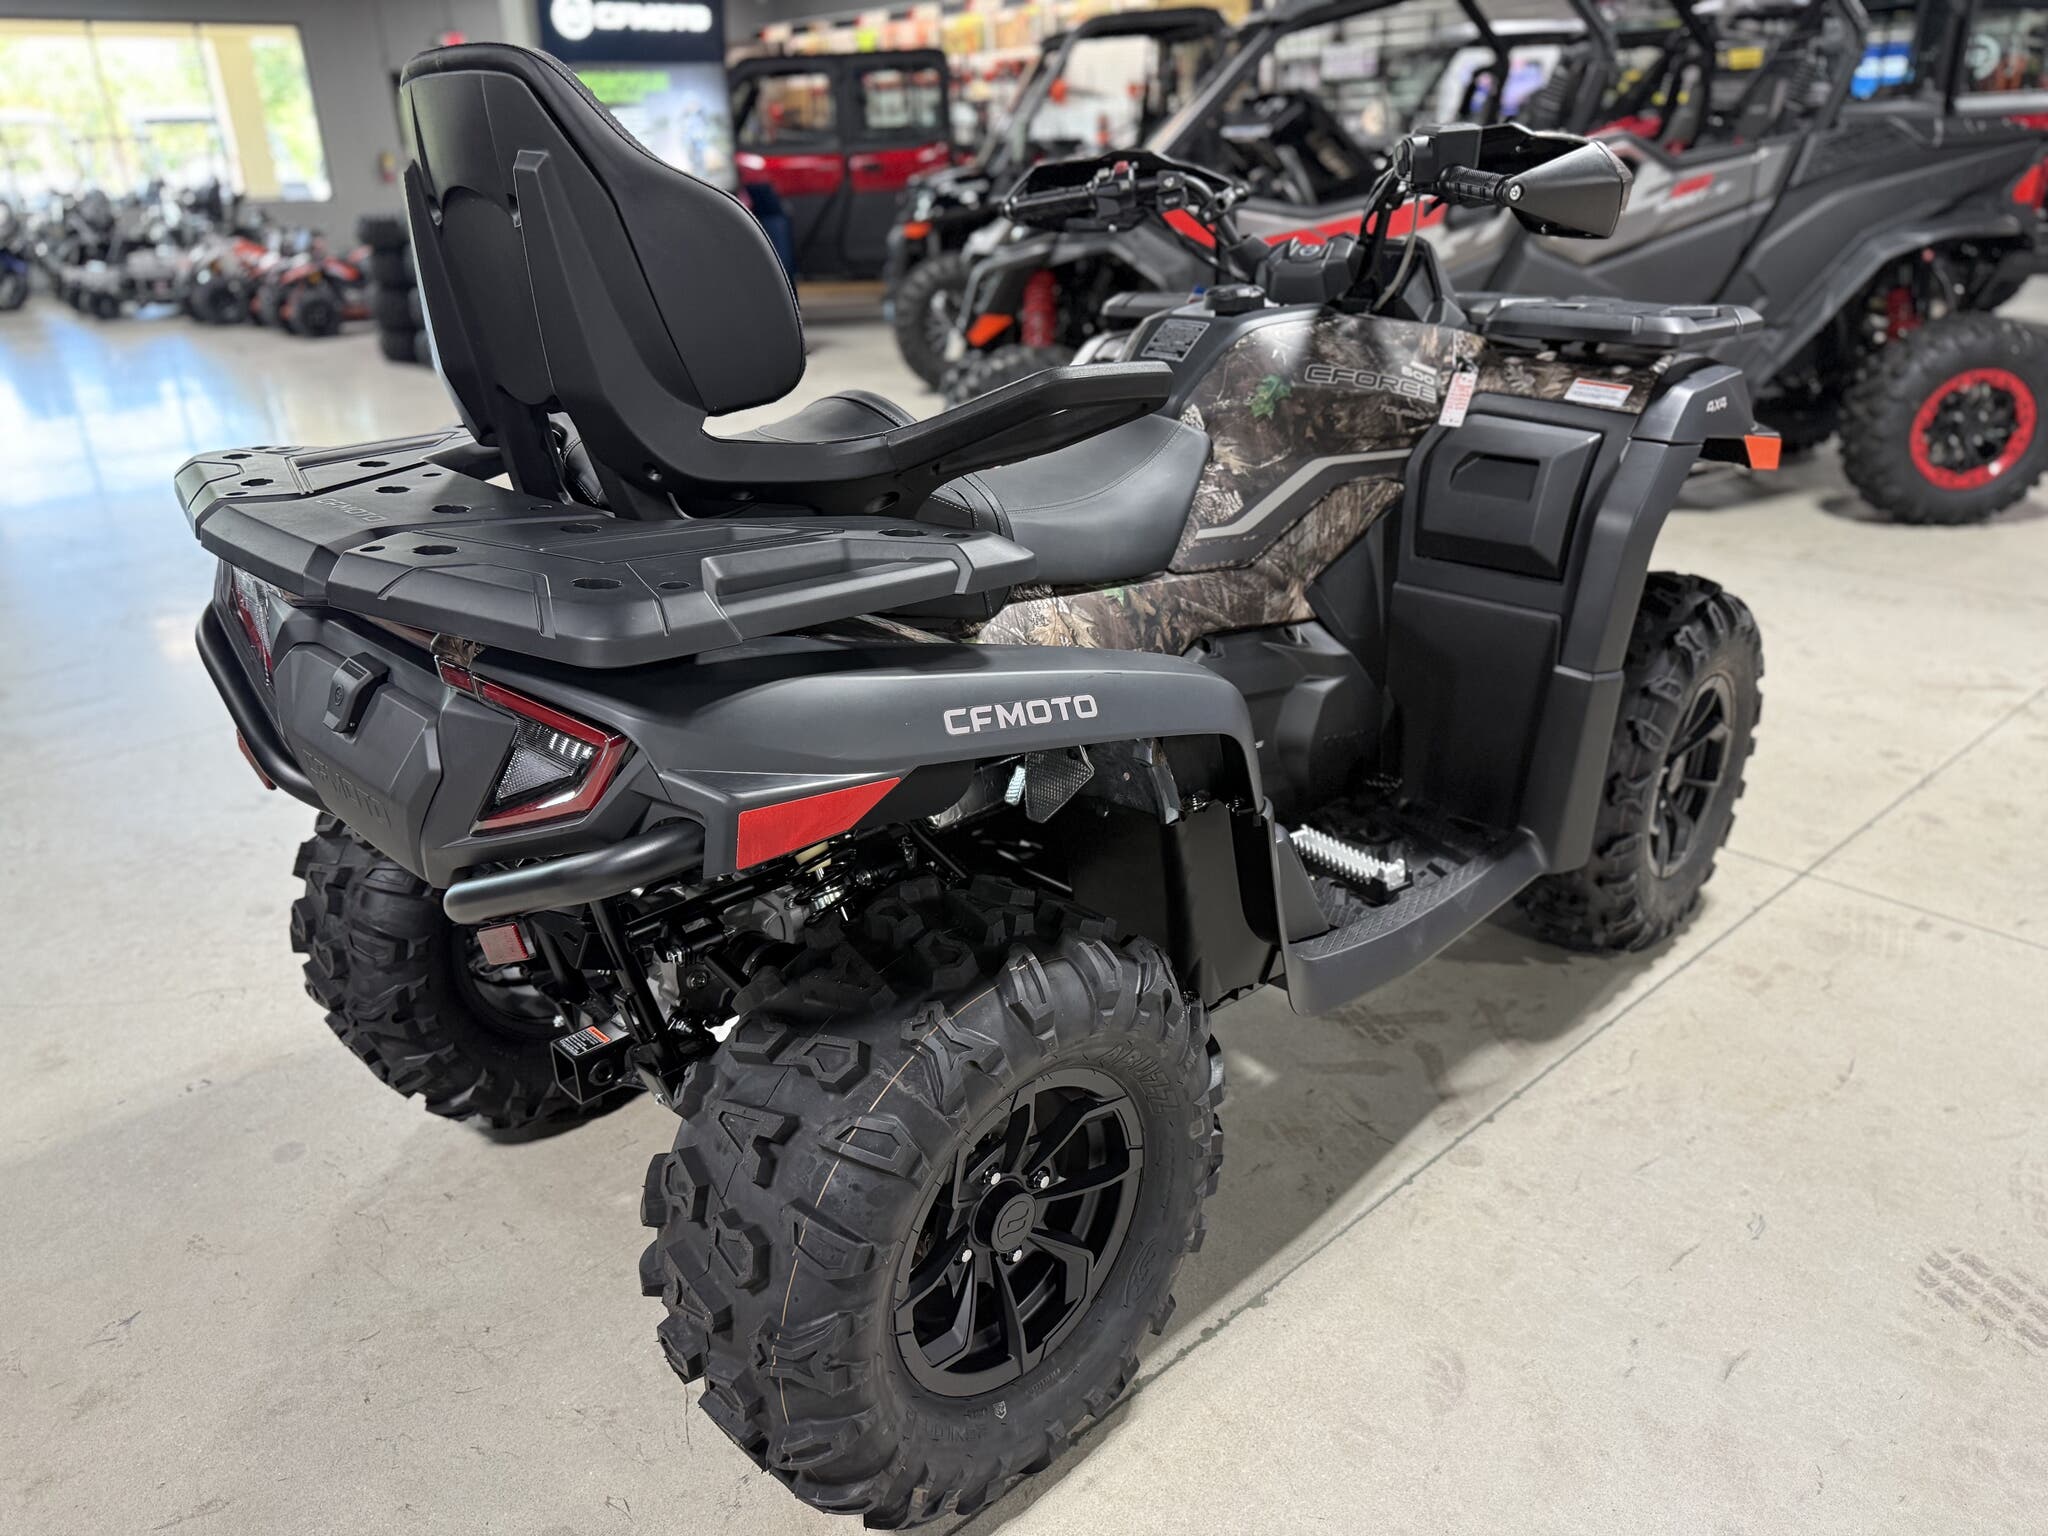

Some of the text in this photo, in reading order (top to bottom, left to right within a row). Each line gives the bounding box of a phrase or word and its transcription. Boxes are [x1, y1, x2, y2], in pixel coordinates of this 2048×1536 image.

[1304, 364, 1438, 404] CFORCE
[315, 498, 388, 522] CFMOTO
[943, 694, 1098, 736] CFMOTO
